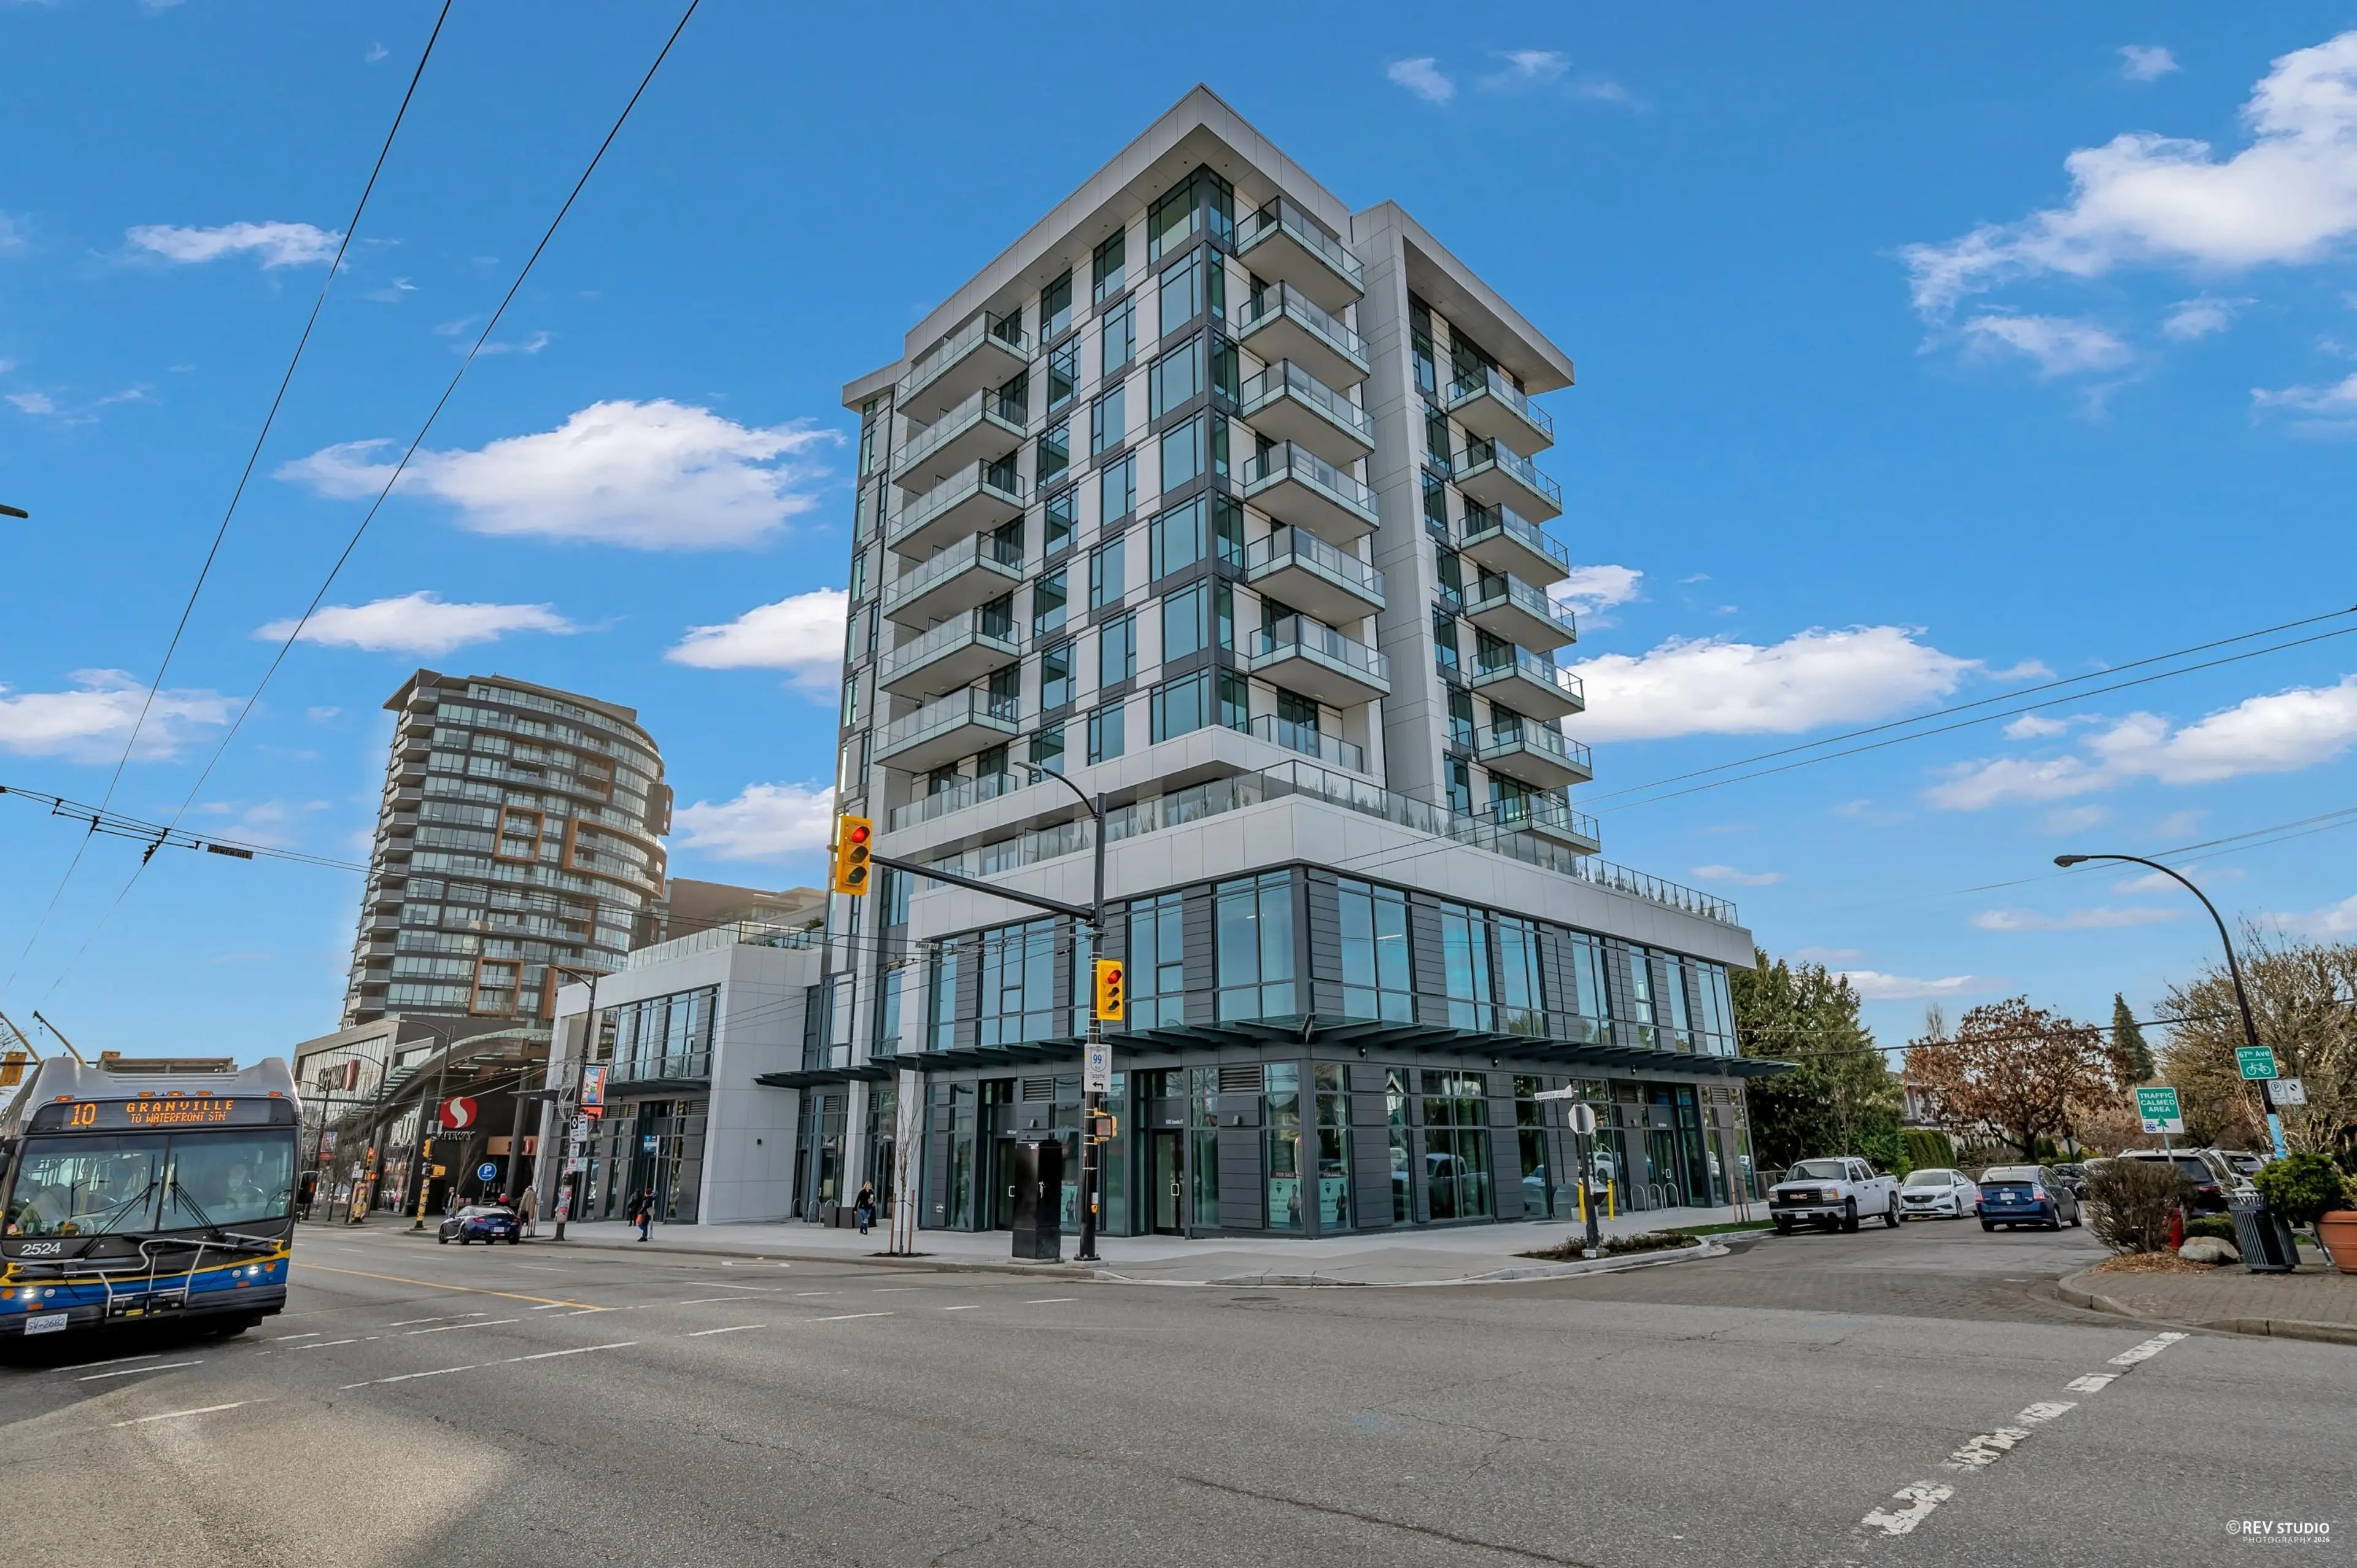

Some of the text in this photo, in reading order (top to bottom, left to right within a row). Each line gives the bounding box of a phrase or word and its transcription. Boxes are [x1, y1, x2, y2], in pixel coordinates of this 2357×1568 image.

[1093, 1054, 1102, 1064] 99
[71, 1100, 234, 1126] 10 GRANVILLE
[131, 1110, 226, 1124] TO WATERFRONT STN
[484, 1165, 492, 1174] P
[20, 1242, 61, 1256] 2524
[27, 1318, 65, 1330] SV-2682
